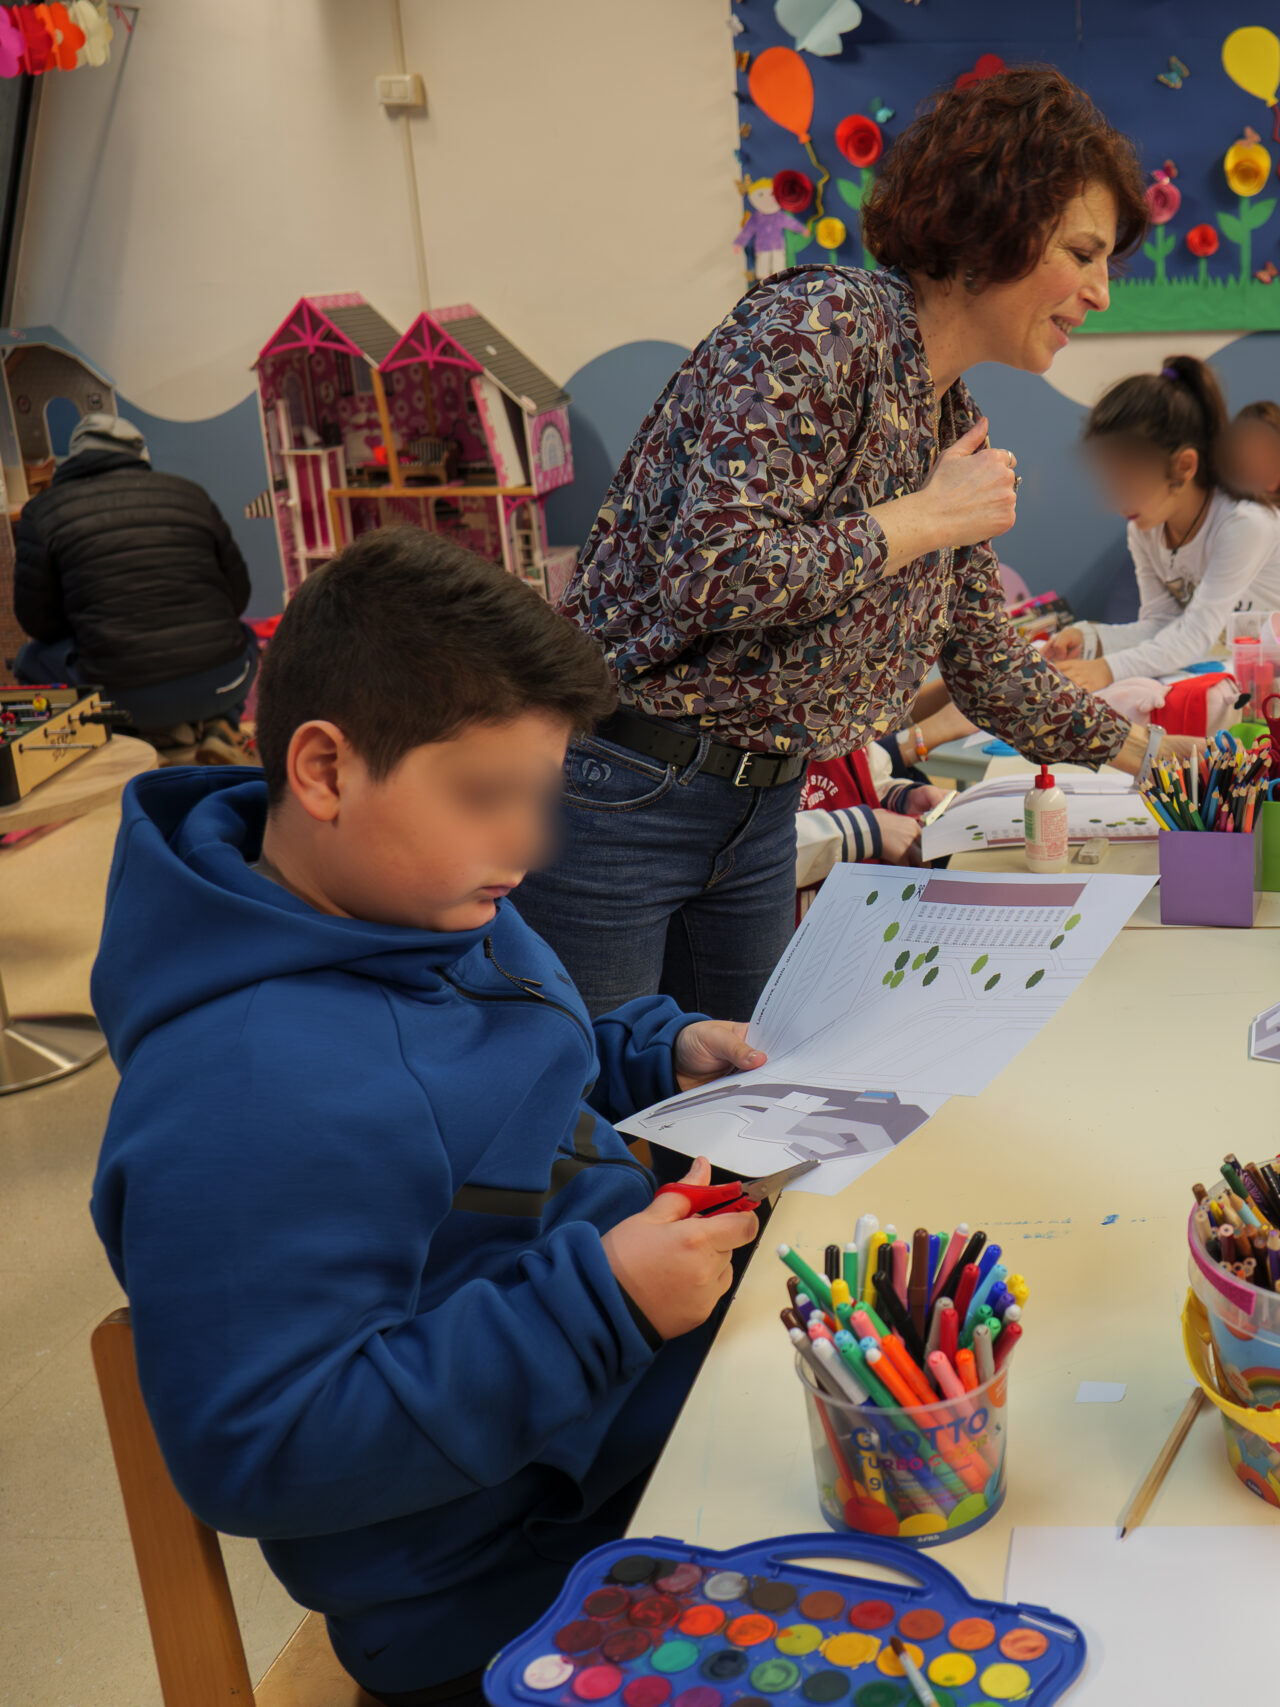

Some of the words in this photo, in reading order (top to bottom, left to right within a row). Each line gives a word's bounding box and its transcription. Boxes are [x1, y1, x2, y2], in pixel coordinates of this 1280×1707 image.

[810, 774, 839, 797] STATE
[851, 1407, 989, 1454] GIOTTO
[856, 1453, 924, 1471] TURBO
[928, 1433, 989, 1468] COLOR
